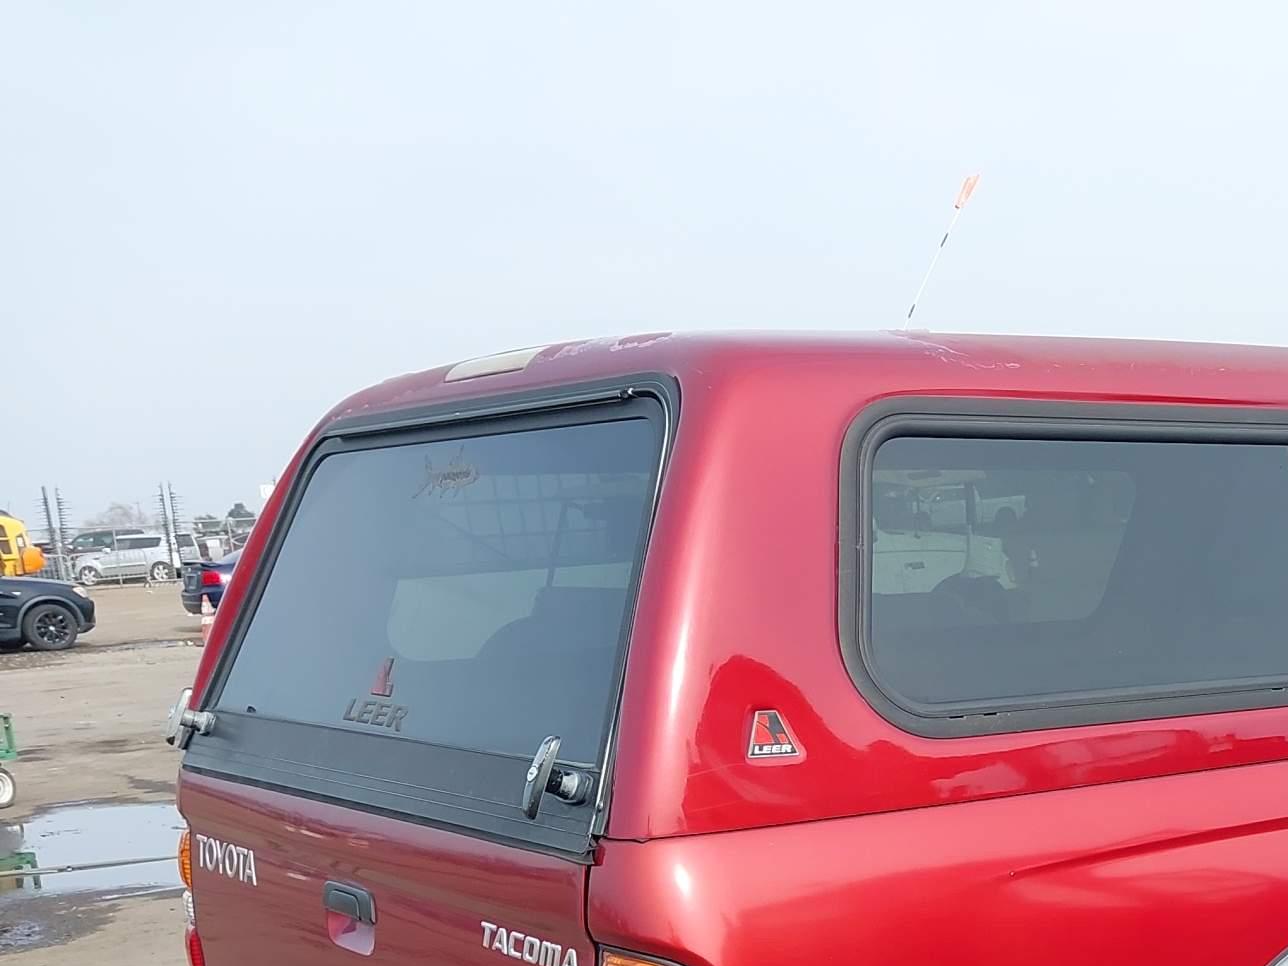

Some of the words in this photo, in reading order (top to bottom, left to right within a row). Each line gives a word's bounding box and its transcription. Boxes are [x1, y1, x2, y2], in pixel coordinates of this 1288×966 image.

[343, 698, 409, 732] LEER
[753, 744, 792, 754] LEER
[196, 833, 257, 886] TOYOTA
